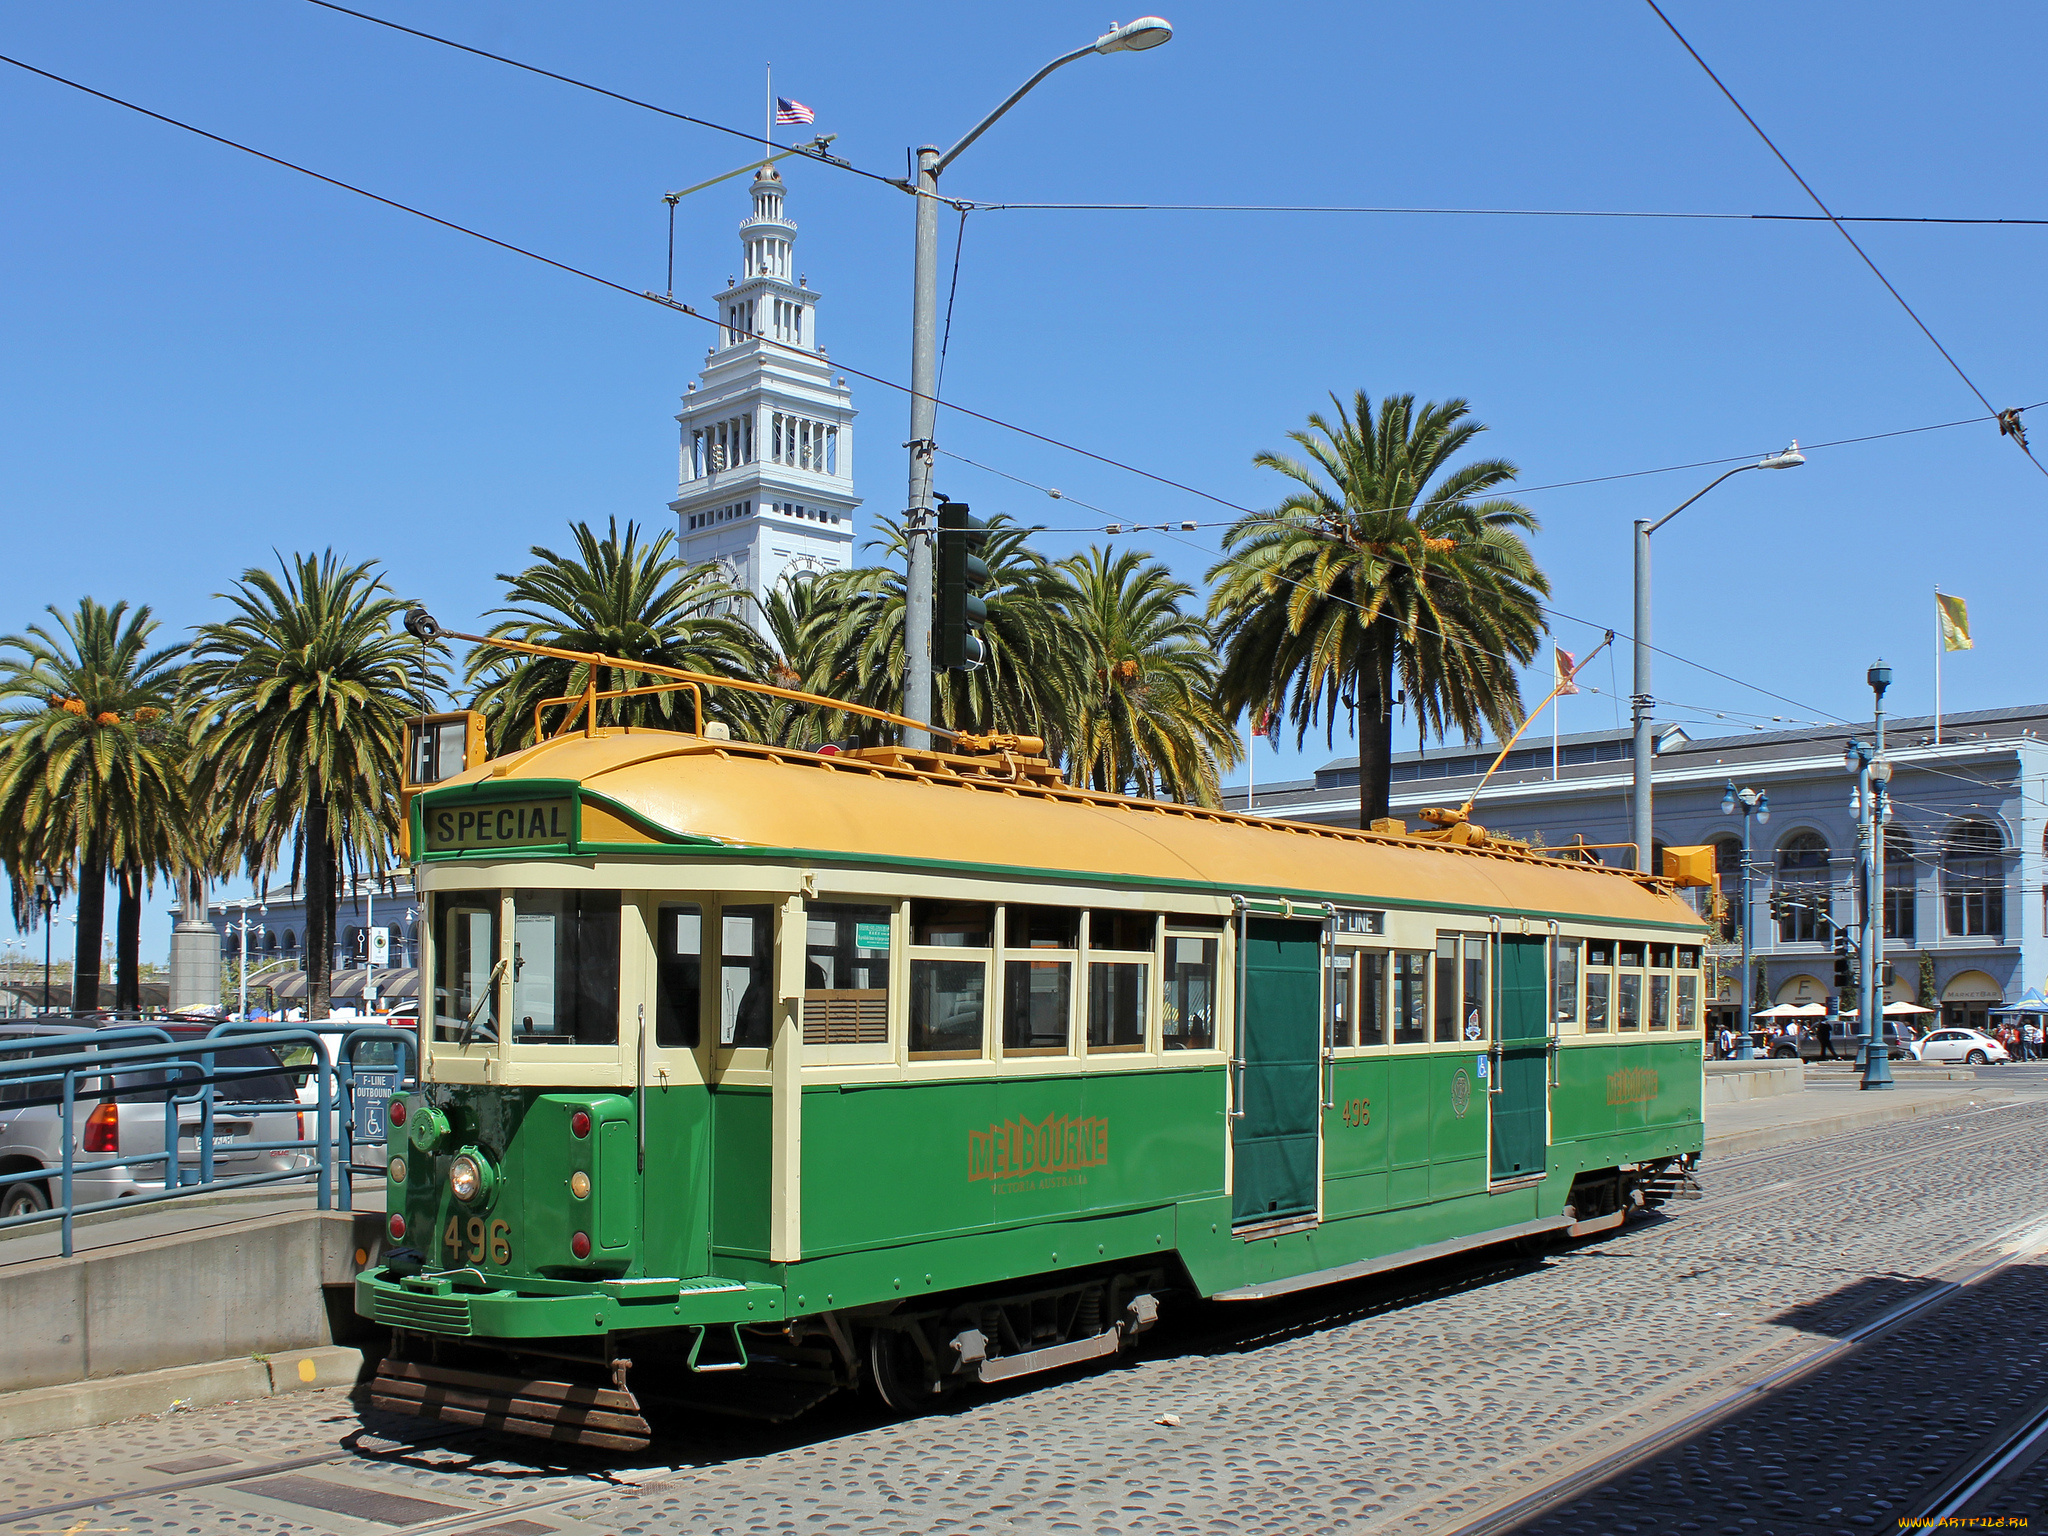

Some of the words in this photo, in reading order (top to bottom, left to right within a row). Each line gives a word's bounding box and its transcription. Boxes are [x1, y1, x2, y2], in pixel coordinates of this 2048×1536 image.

[416, 736, 431, 782] F
[437, 807, 567, 843] SPECIAL
[1348, 912, 1374, 933] LINE
[1798, 980, 1811, 995] F
[357, 1087, 392, 1098] OUTBOUND
[363, 1075, 386, 1086] F-LINE
[1342, 1098, 1371, 1128] 496
[968, 1111, 1109, 1182] MELBOURNE
[991, 1179, 1036, 1195] VICTORIA
[1039, 1174, 1089, 1190] AUSTRALIA
[444, 1215, 512, 1265] 496
